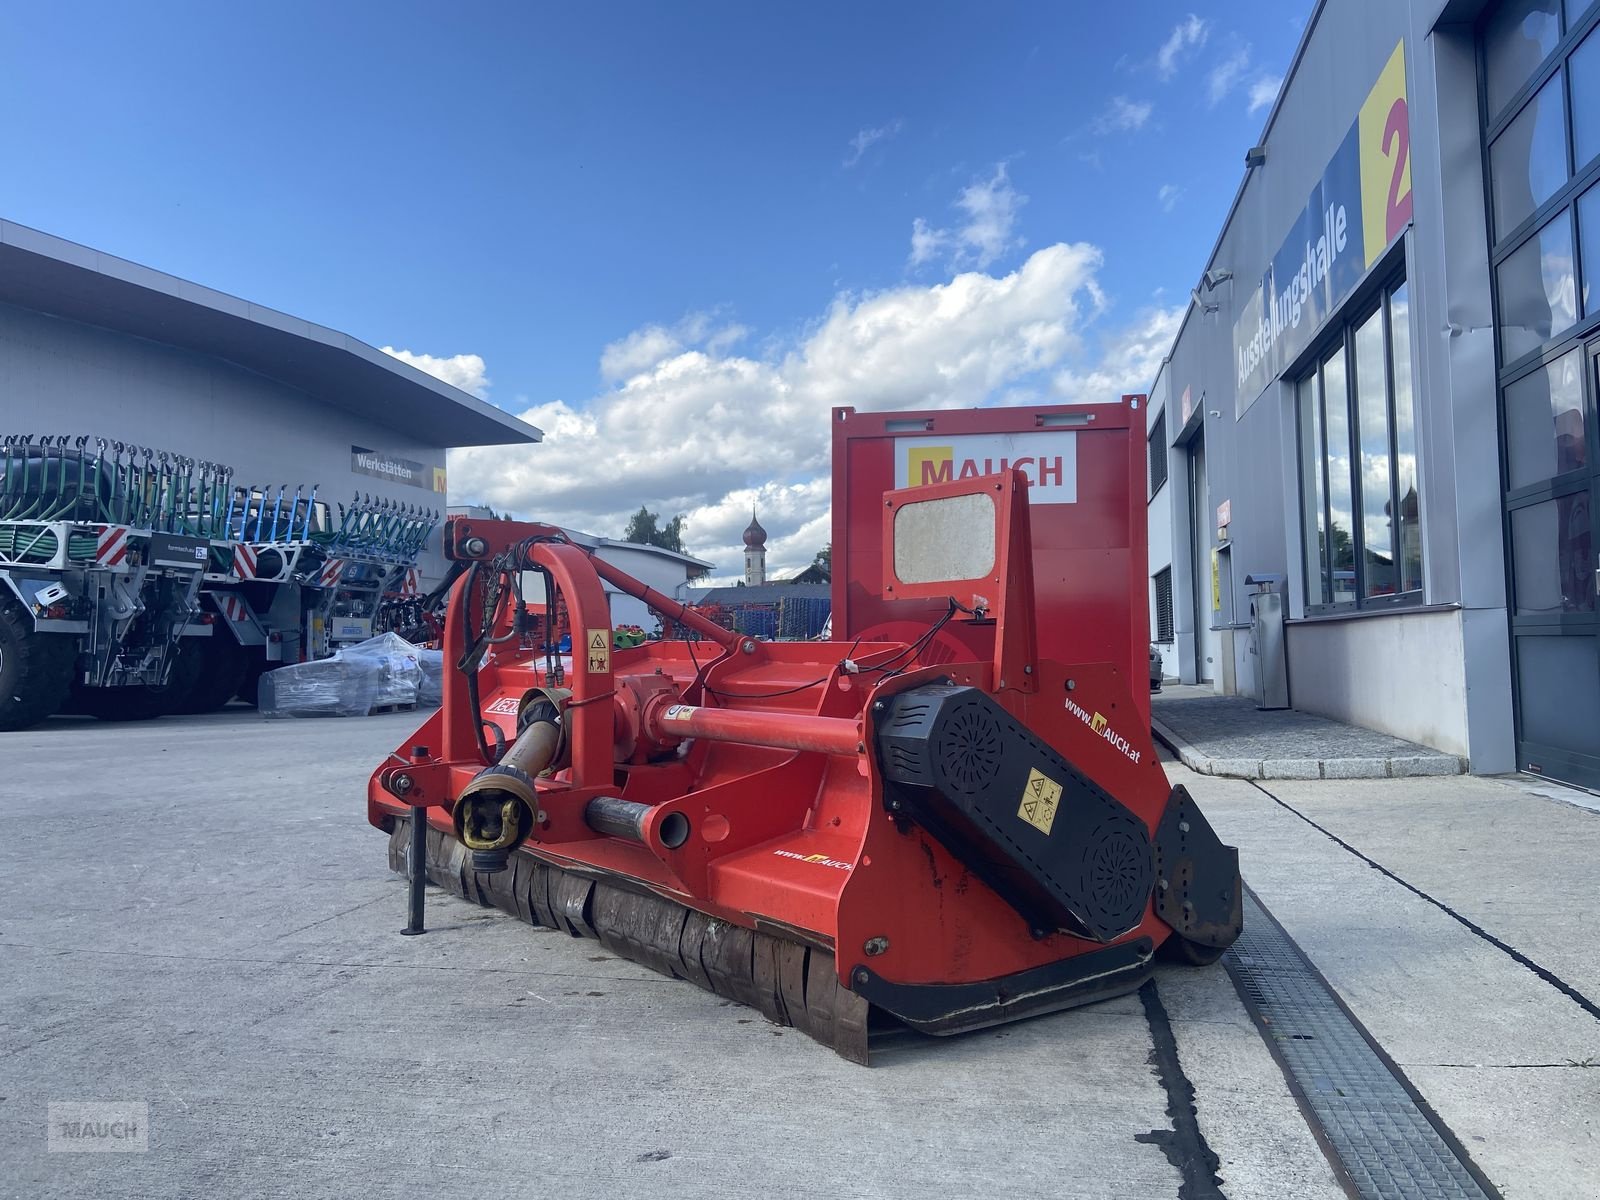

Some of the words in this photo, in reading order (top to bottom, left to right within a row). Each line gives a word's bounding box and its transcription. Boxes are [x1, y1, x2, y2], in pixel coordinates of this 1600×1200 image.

[1237, 202, 1348, 389] Ausstellungshalle
[1382, 98, 1413, 246] 2
[357, 453, 412, 479] Werkstätten
[921, 456, 1063, 488] MAUCH
[1064, 697, 1141, 764] www.MAUCH.at
